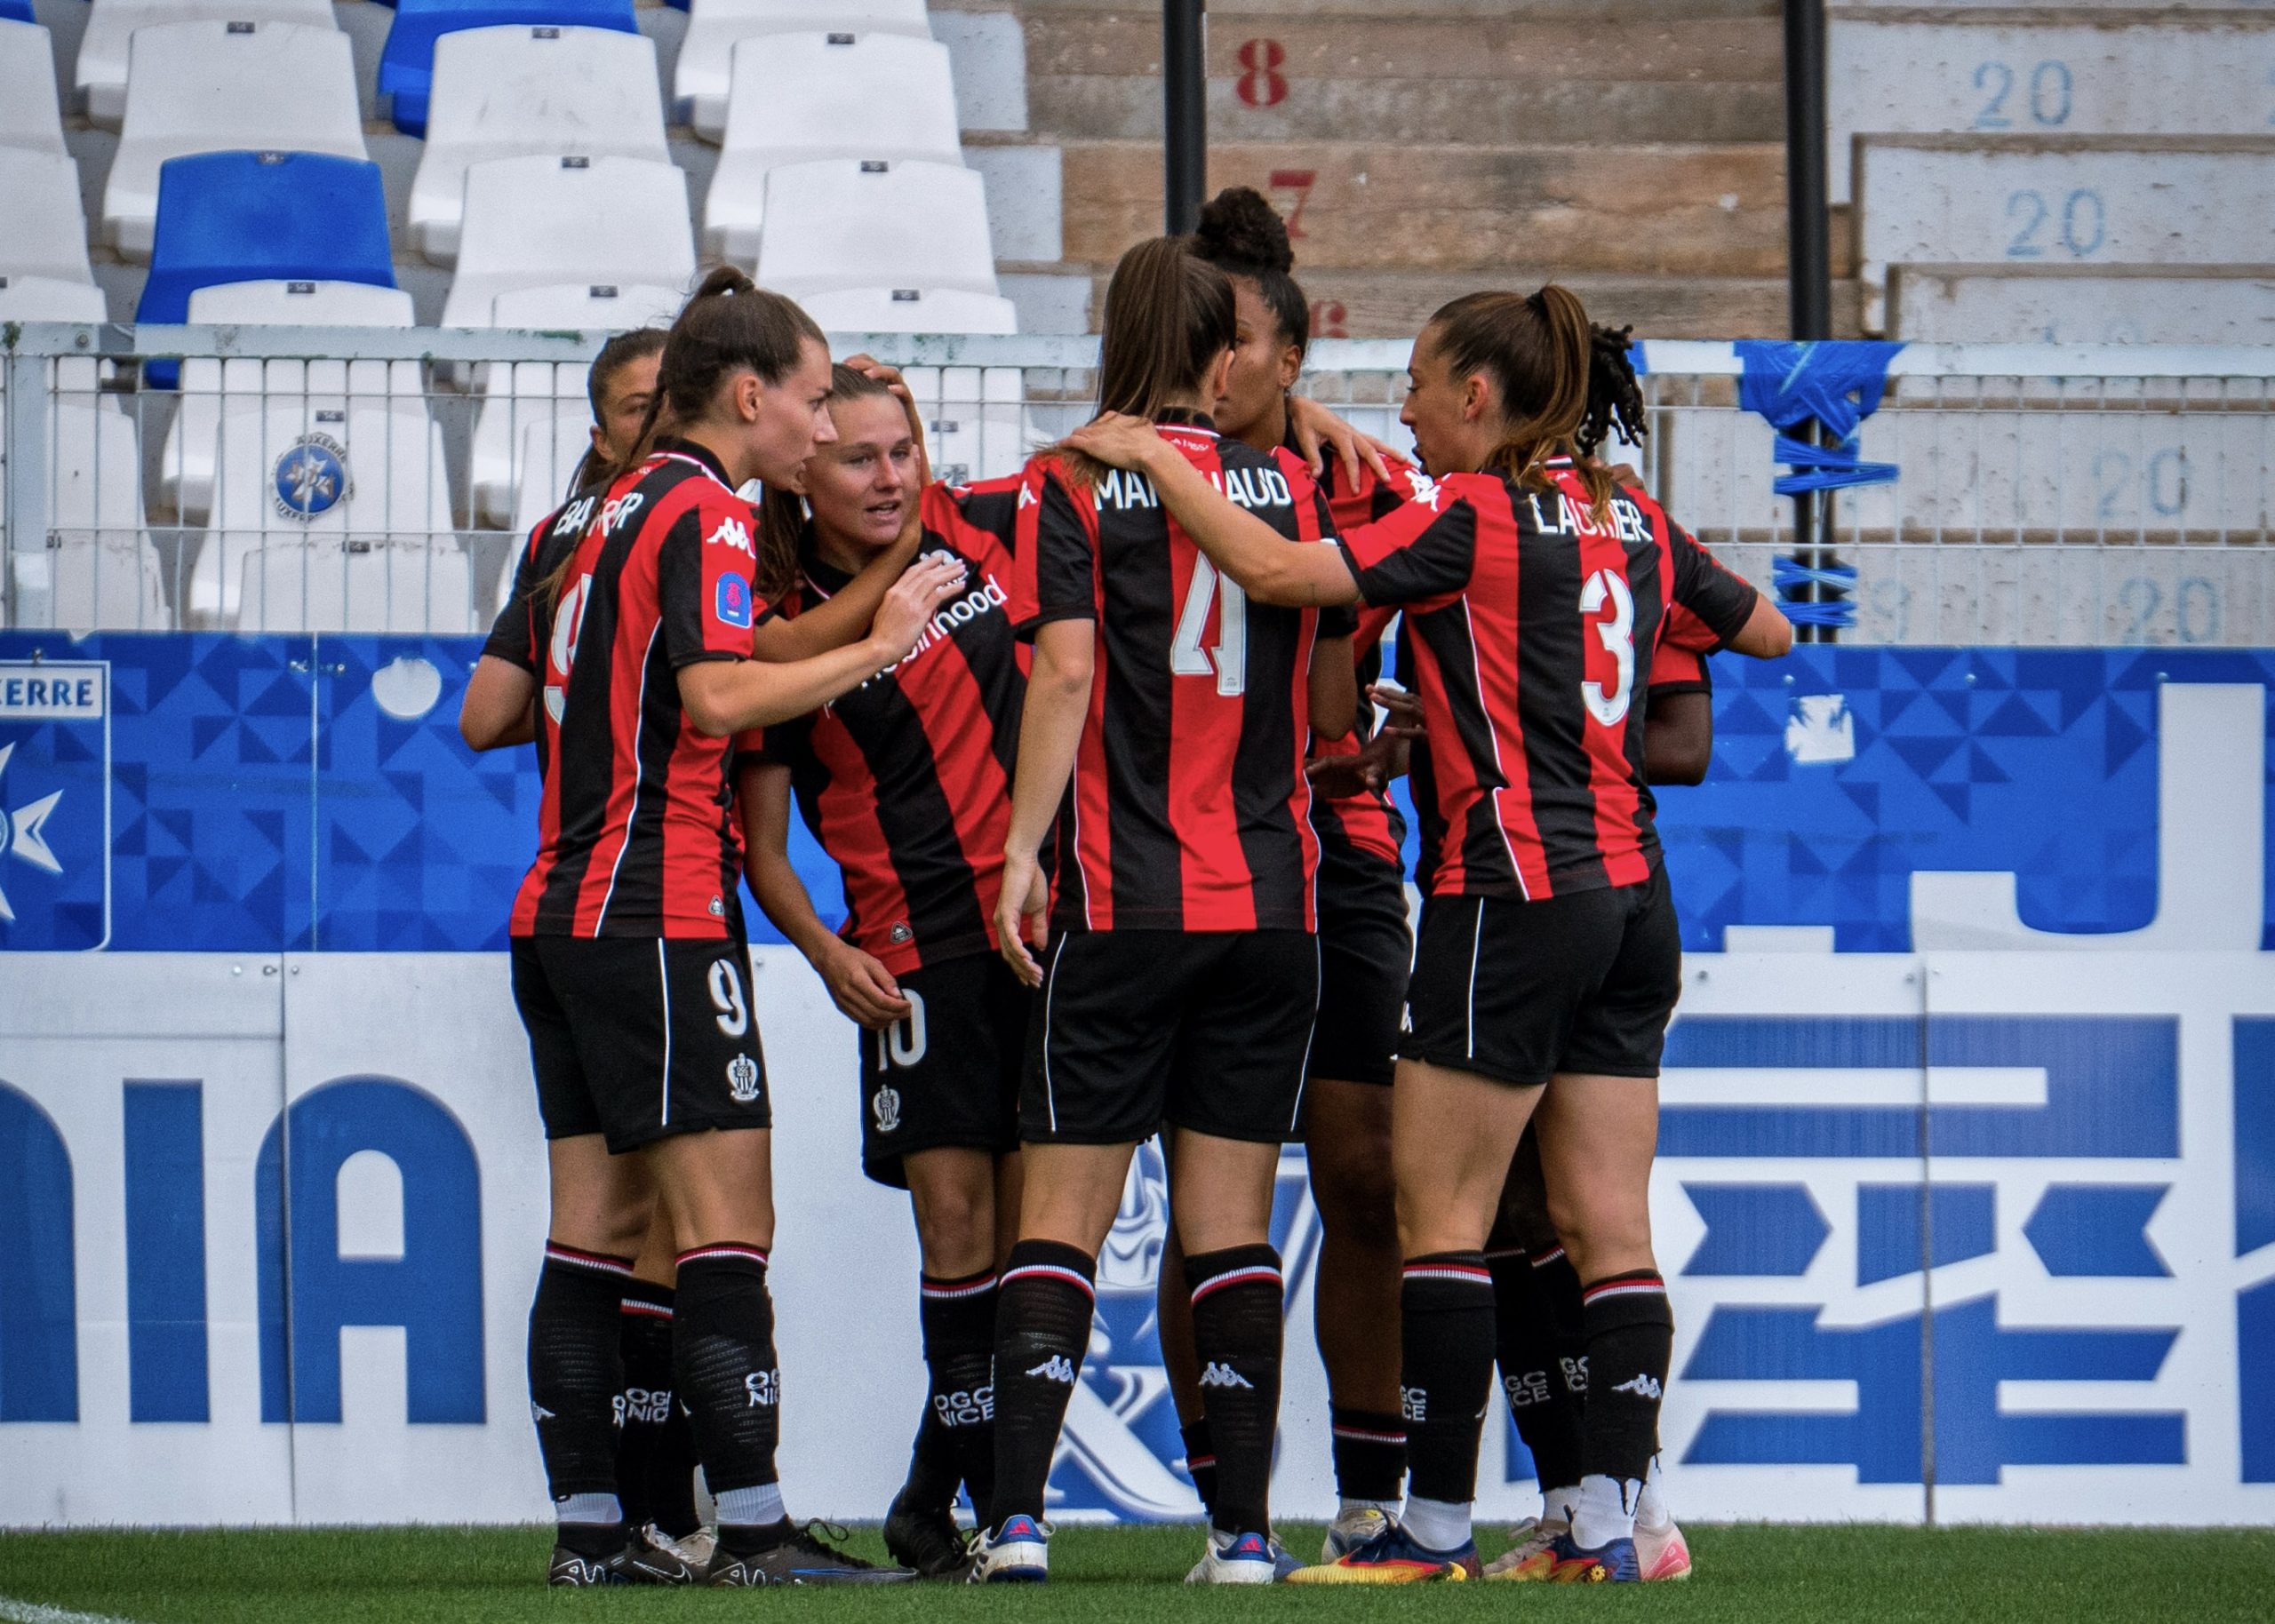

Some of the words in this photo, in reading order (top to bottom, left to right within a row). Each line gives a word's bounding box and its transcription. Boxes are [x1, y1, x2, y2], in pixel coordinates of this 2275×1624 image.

[1237, 38, 1288, 107] 8
[1972, 60, 2072, 127] 20
[1269, 170, 1316, 238] 7
[2006, 187, 2104, 256] 20
[2090, 448, 2189, 517] 20
[1170, 549, 1245, 696] 4
[1579, 569, 1633, 726] 3
[0, 678, 93, 706] ERRE
[708, 959, 746, 1037] 9
[1505, 1370, 1547, 1392] GC
